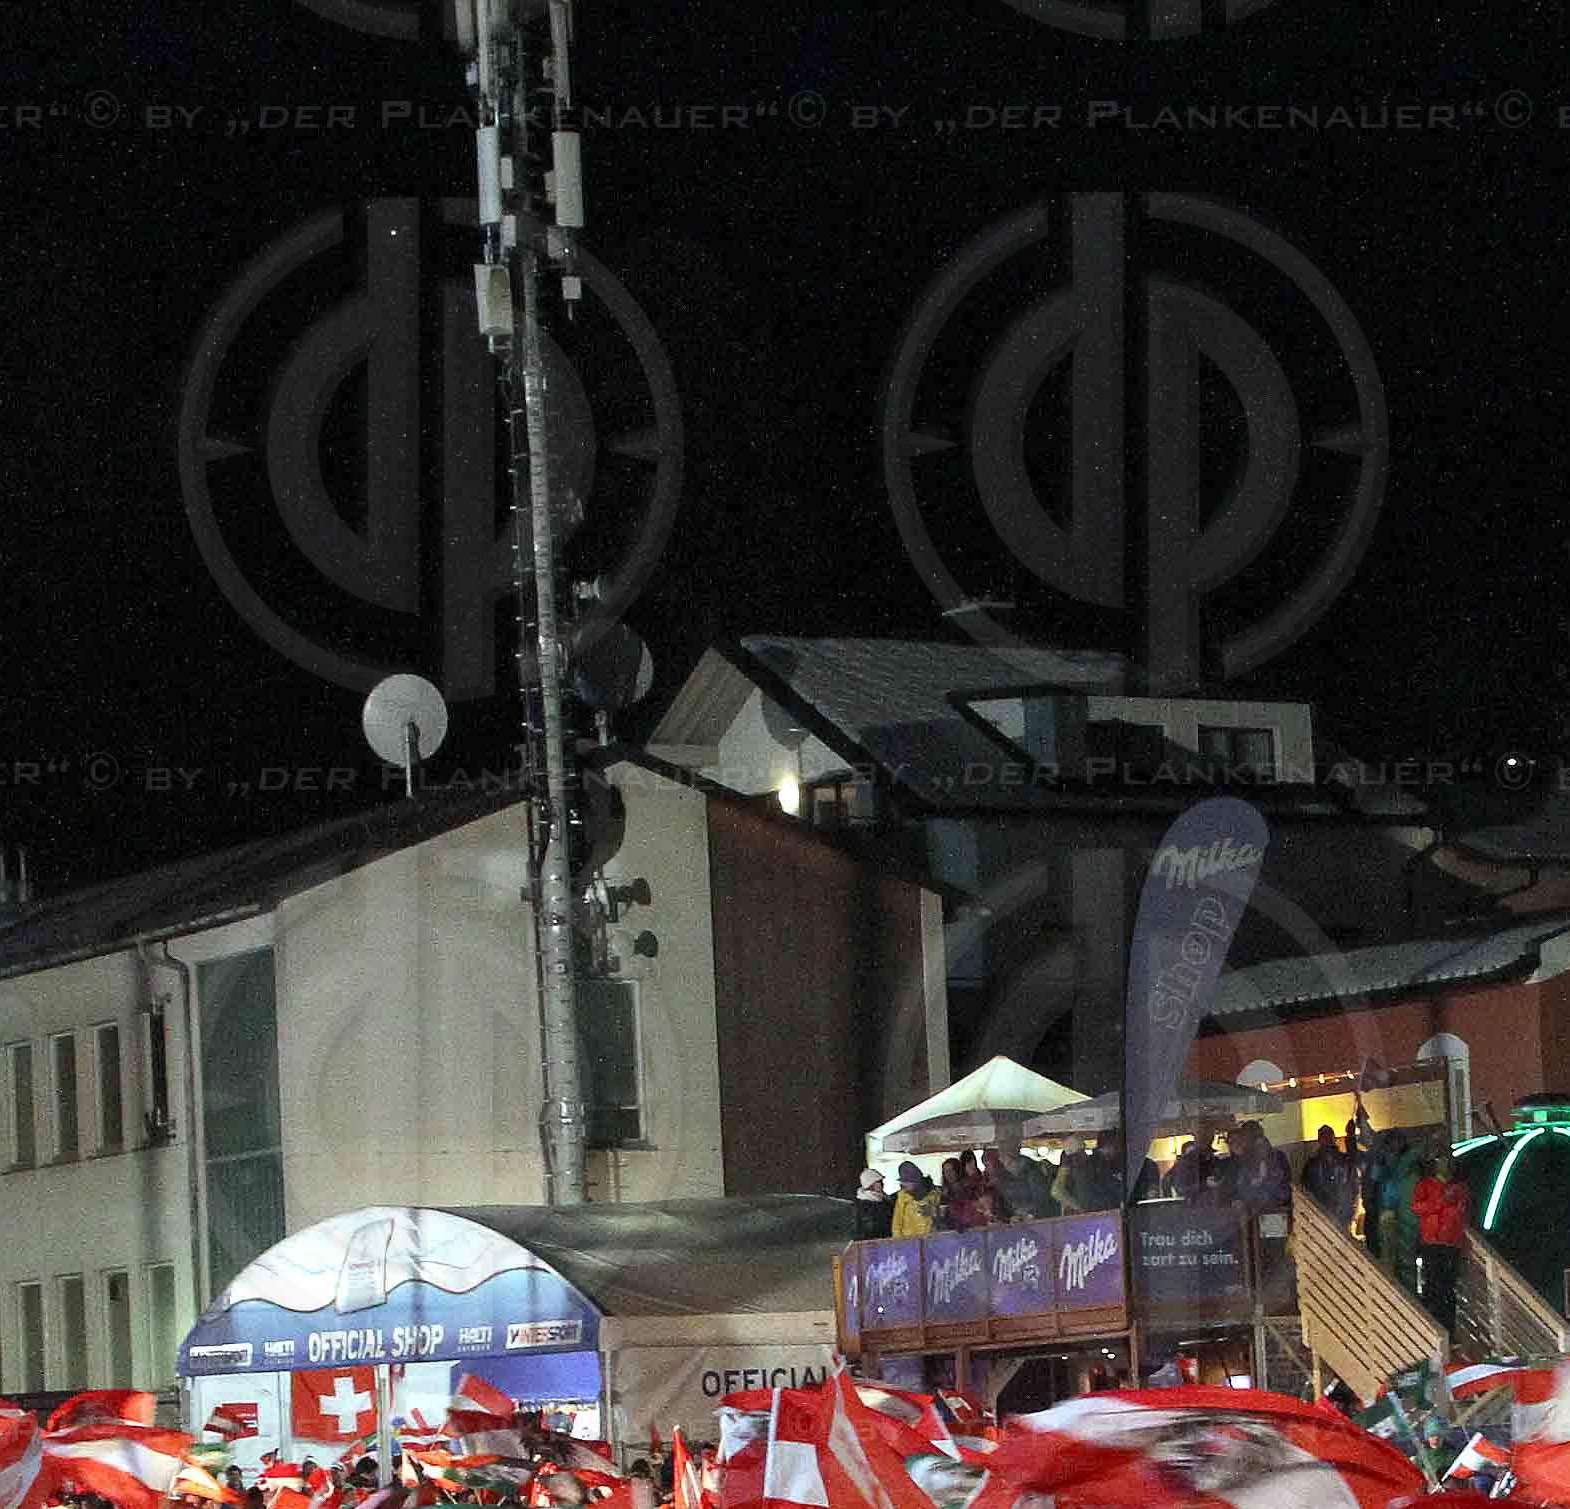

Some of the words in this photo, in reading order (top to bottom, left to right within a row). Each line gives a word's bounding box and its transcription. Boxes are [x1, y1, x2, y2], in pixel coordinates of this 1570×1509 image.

[1059, 1228, 1118, 1291] Milka
[308, 1328, 386, 1363] OFFICIAL
[391, 1323, 446, 1357] SHOP
